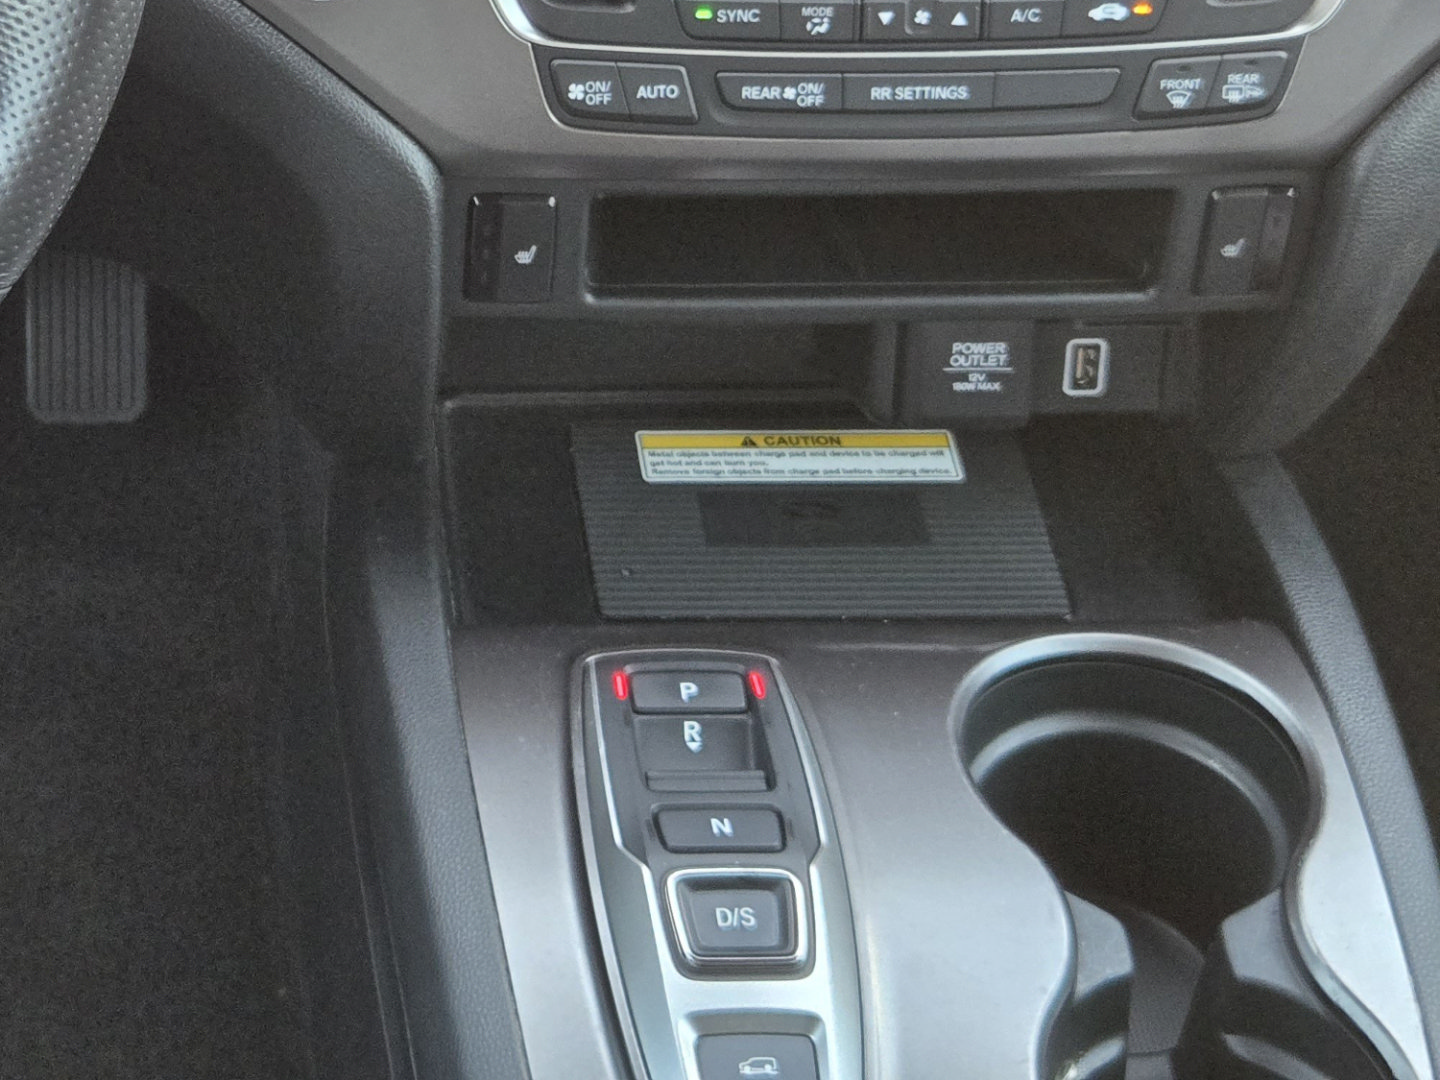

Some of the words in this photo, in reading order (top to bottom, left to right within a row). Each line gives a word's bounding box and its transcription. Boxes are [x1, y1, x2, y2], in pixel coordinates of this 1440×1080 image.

[716, 8, 761, 24] SYNC
[801, 6, 835, 18] MODE
[1010, 7, 1041, 24] A/C
[1159, 78, 1201, 91] FRONT
[1226, 72, 1260, 85] REAR
[636, 84, 679, 100] AUTO
[741, 85, 782, 100] REAR
[870, 86, 891, 101] RR
[893, 86, 970, 101] SETTINGS
[585, 93, 613, 107] OFF
[796, 94, 825, 108] OFF
[951, 342, 1009, 354] POWER
[949, 354, 1010, 367] OUTLET
[977, 381, 1002, 391] MAX
[763, 435, 841, 447] CAUTION
[679, 682, 699, 703] P
[683, 721, 702, 742] R
[711, 817, 734, 837] N
[715, 906, 757, 929] D/S
